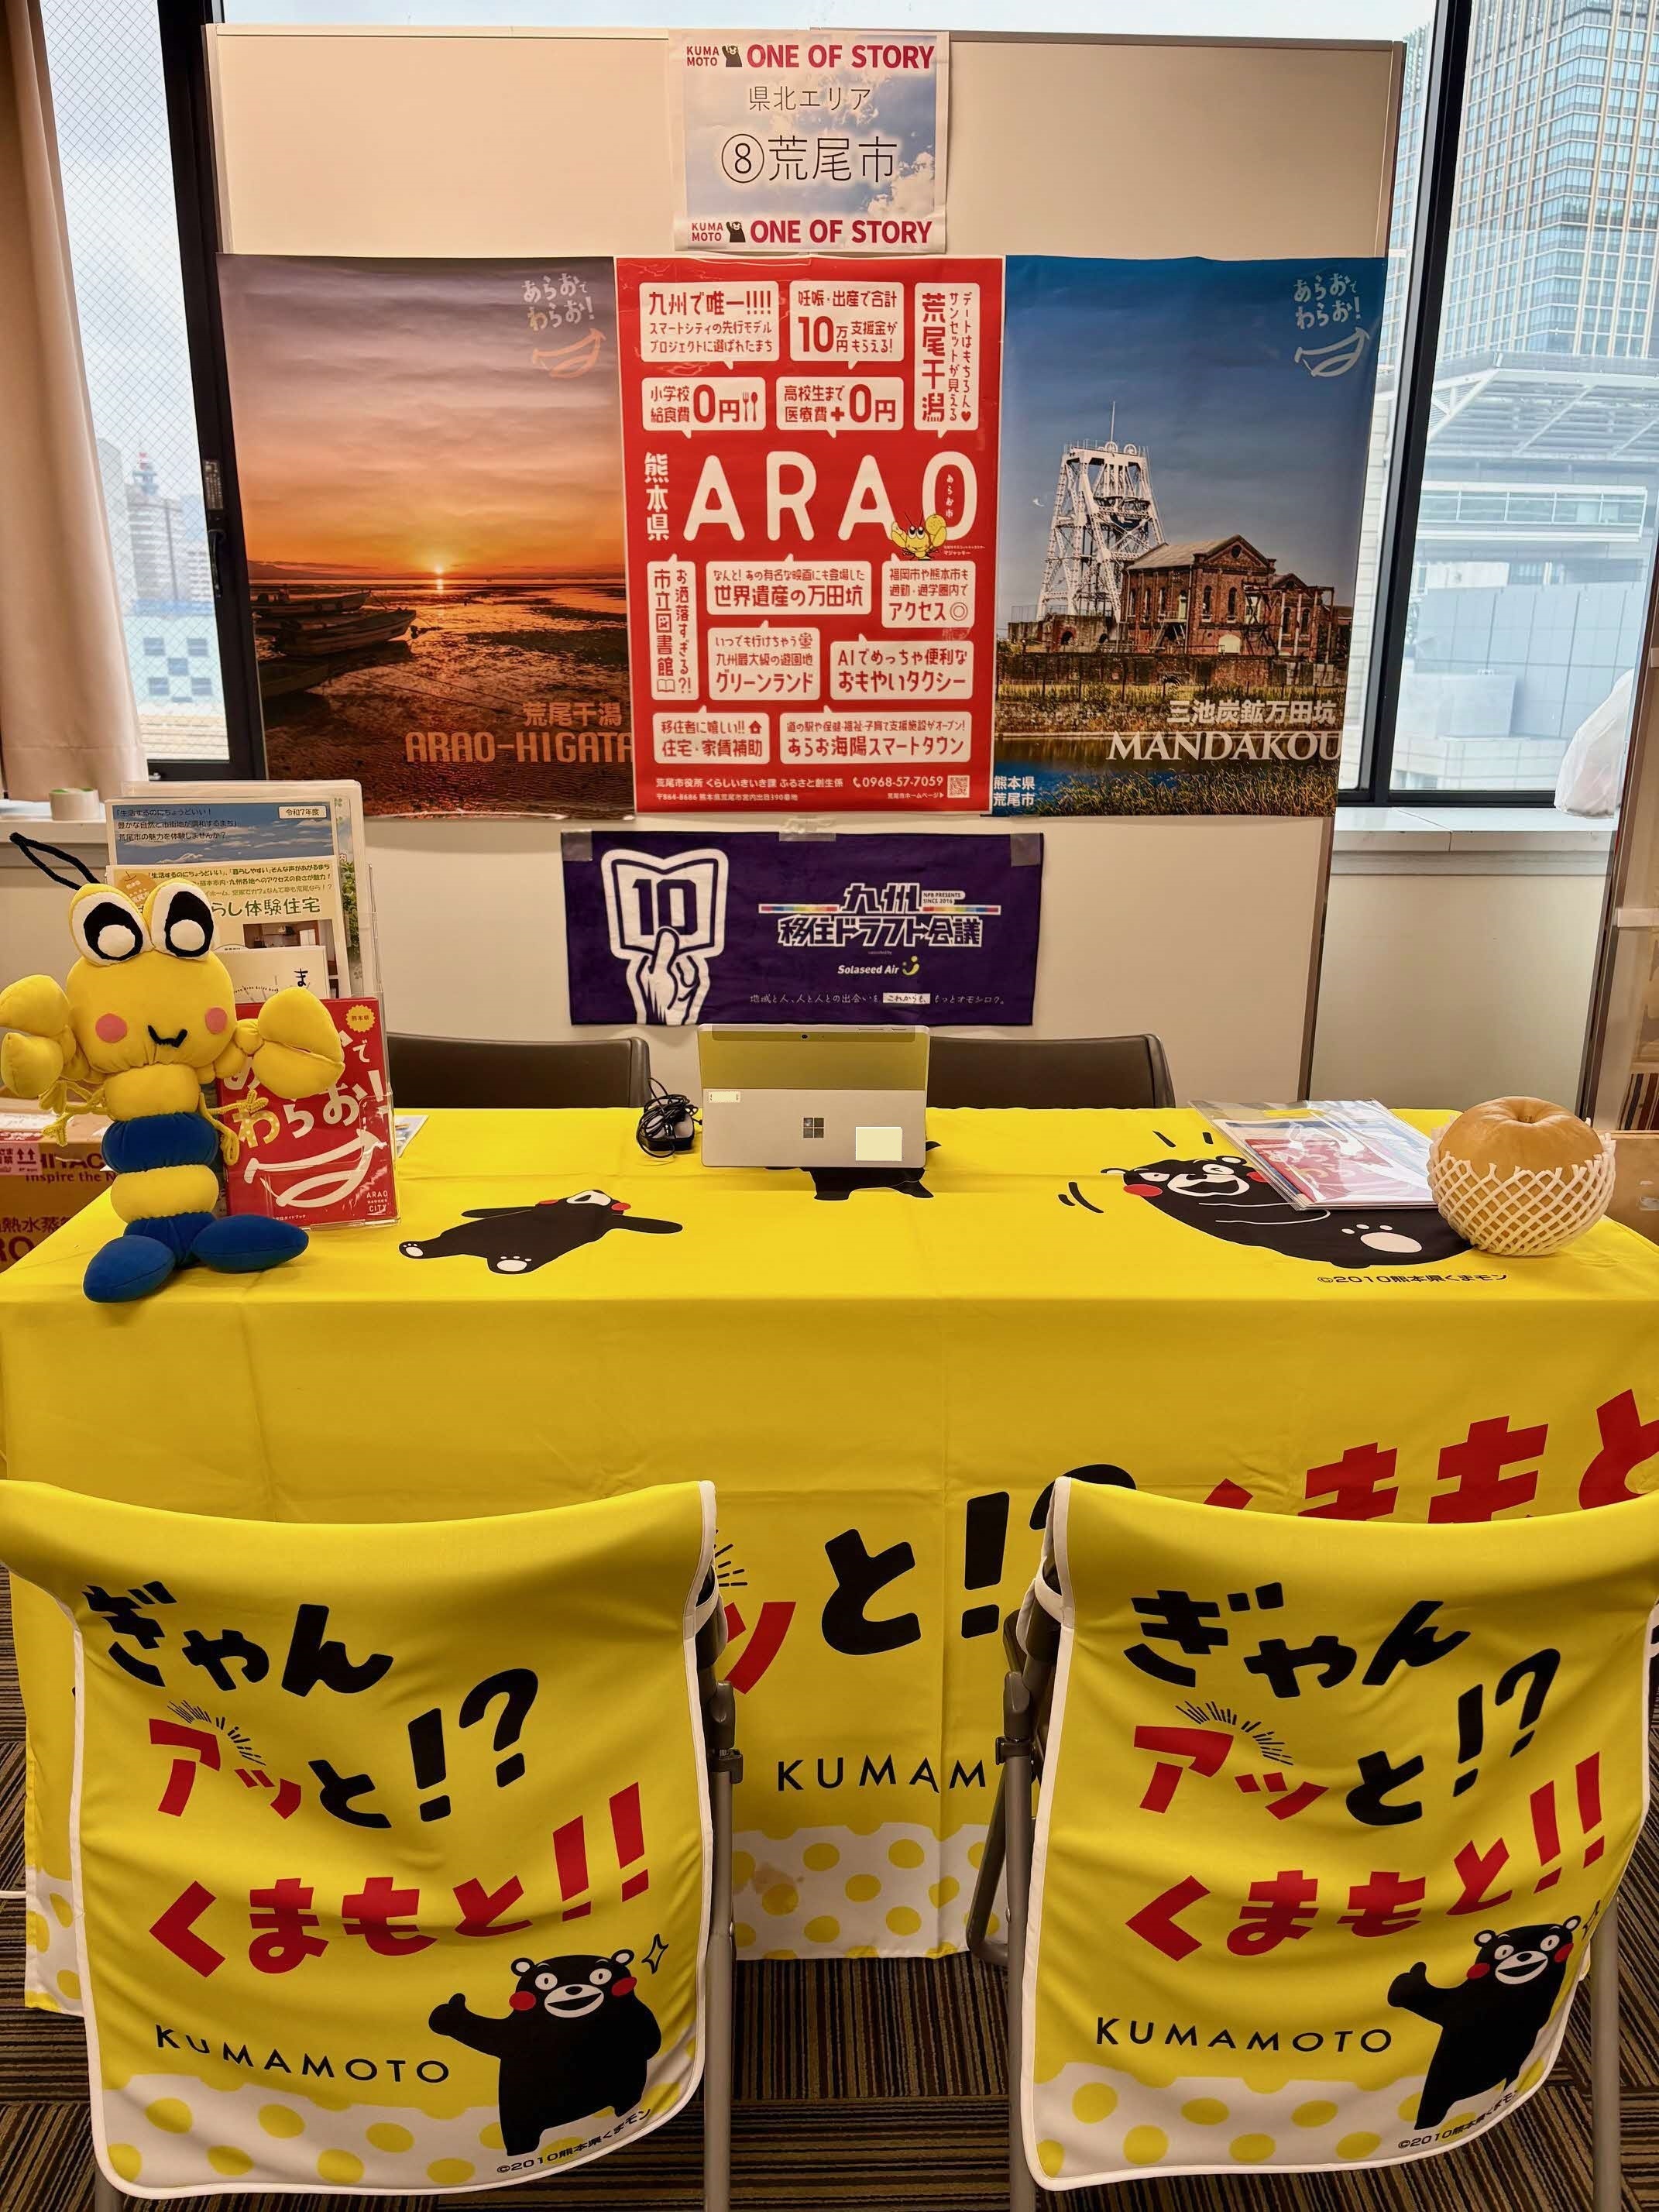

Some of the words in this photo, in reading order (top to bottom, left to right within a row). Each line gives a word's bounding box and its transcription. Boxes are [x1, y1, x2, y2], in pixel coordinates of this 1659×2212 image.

[686, 46, 720, 56] KUMA
[747, 43, 799, 68] ONE
[808, 44, 843, 68] OF
[851, 44, 935, 69] STORY
[686, 57, 718, 67] MOTO
[749, 86, 871, 111] 県北エリア
[692, 222, 723, 232] KUMA
[692, 232, 722, 242] MOTO
[750, 219, 801, 244] ONE
[809, 219, 843, 244] OF
[852, 220, 933, 244] STORY
[649, 321, 772, 335] スマートシティの先行モデル
[851, 321, 898, 336] 支援金が
[650, 338, 773, 353] プロジェクトに選ばれたまち
[922, 292, 946, 423] 荒尾干潟
[948, 292, 960, 422] サンセットが見える
[651, 385, 690, 402] 小学校
[784, 384, 845, 401] 高校生まで
[651, 406, 690, 424] 給食費
[644, 452, 670, 541] 熊本県
[683, 450, 977, 542] ARAO
[888, 568, 969, 582] 福岡市や熊本市も
[714, 585, 864, 608] 世界遺産の万田坑
[654, 568, 675, 676] 市立図書館
[715, 635, 798, 648] いつでも行けちゃう
[715, 653, 813, 667] 九州最大級の遊園地
[837, 648, 968, 666] AIでめっちゃ便利な
[715, 671, 813, 694] グリーンランド
[837, 671, 967, 693] おもやいタクシー
[522, 701, 622, 726] 荒尾干潟
[1166, 699, 1337, 725] 三池炭鉱万田坑
[661, 738, 763, 757] 住宅・家賃補助
[788, 735, 965, 757] あらお海陽スマートタウン
[1106, 730, 1342, 761] MANDAKOU
[656, 778, 703, 788] 荒尾市役所
[862, 775, 943, 788] 0968-57-7059
[993, 775, 1036, 791] 熊本県
[993, 793, 1036, 806] 荒尾市
[841, 882, 921, 915] 九州
[777, 914, 984, 948] 移住ドラフト会議
[837, 964, 883, 975] Solaseed
[884, 964, 900, 975] Air
[79, 1170, 101, 1182] the
[366, 1190, 388, 1199] ARAO
[81, 1581, 394, 1698] ぎゃん
[1123, 1581, 1472, 1698] ぎゃん
[777, 1754, 987, 1794] KUMAM
[1096, 2016, 1393, 2054] KUMAMOTO
[155, 2024, 450, 2084] KUMAMOTO
